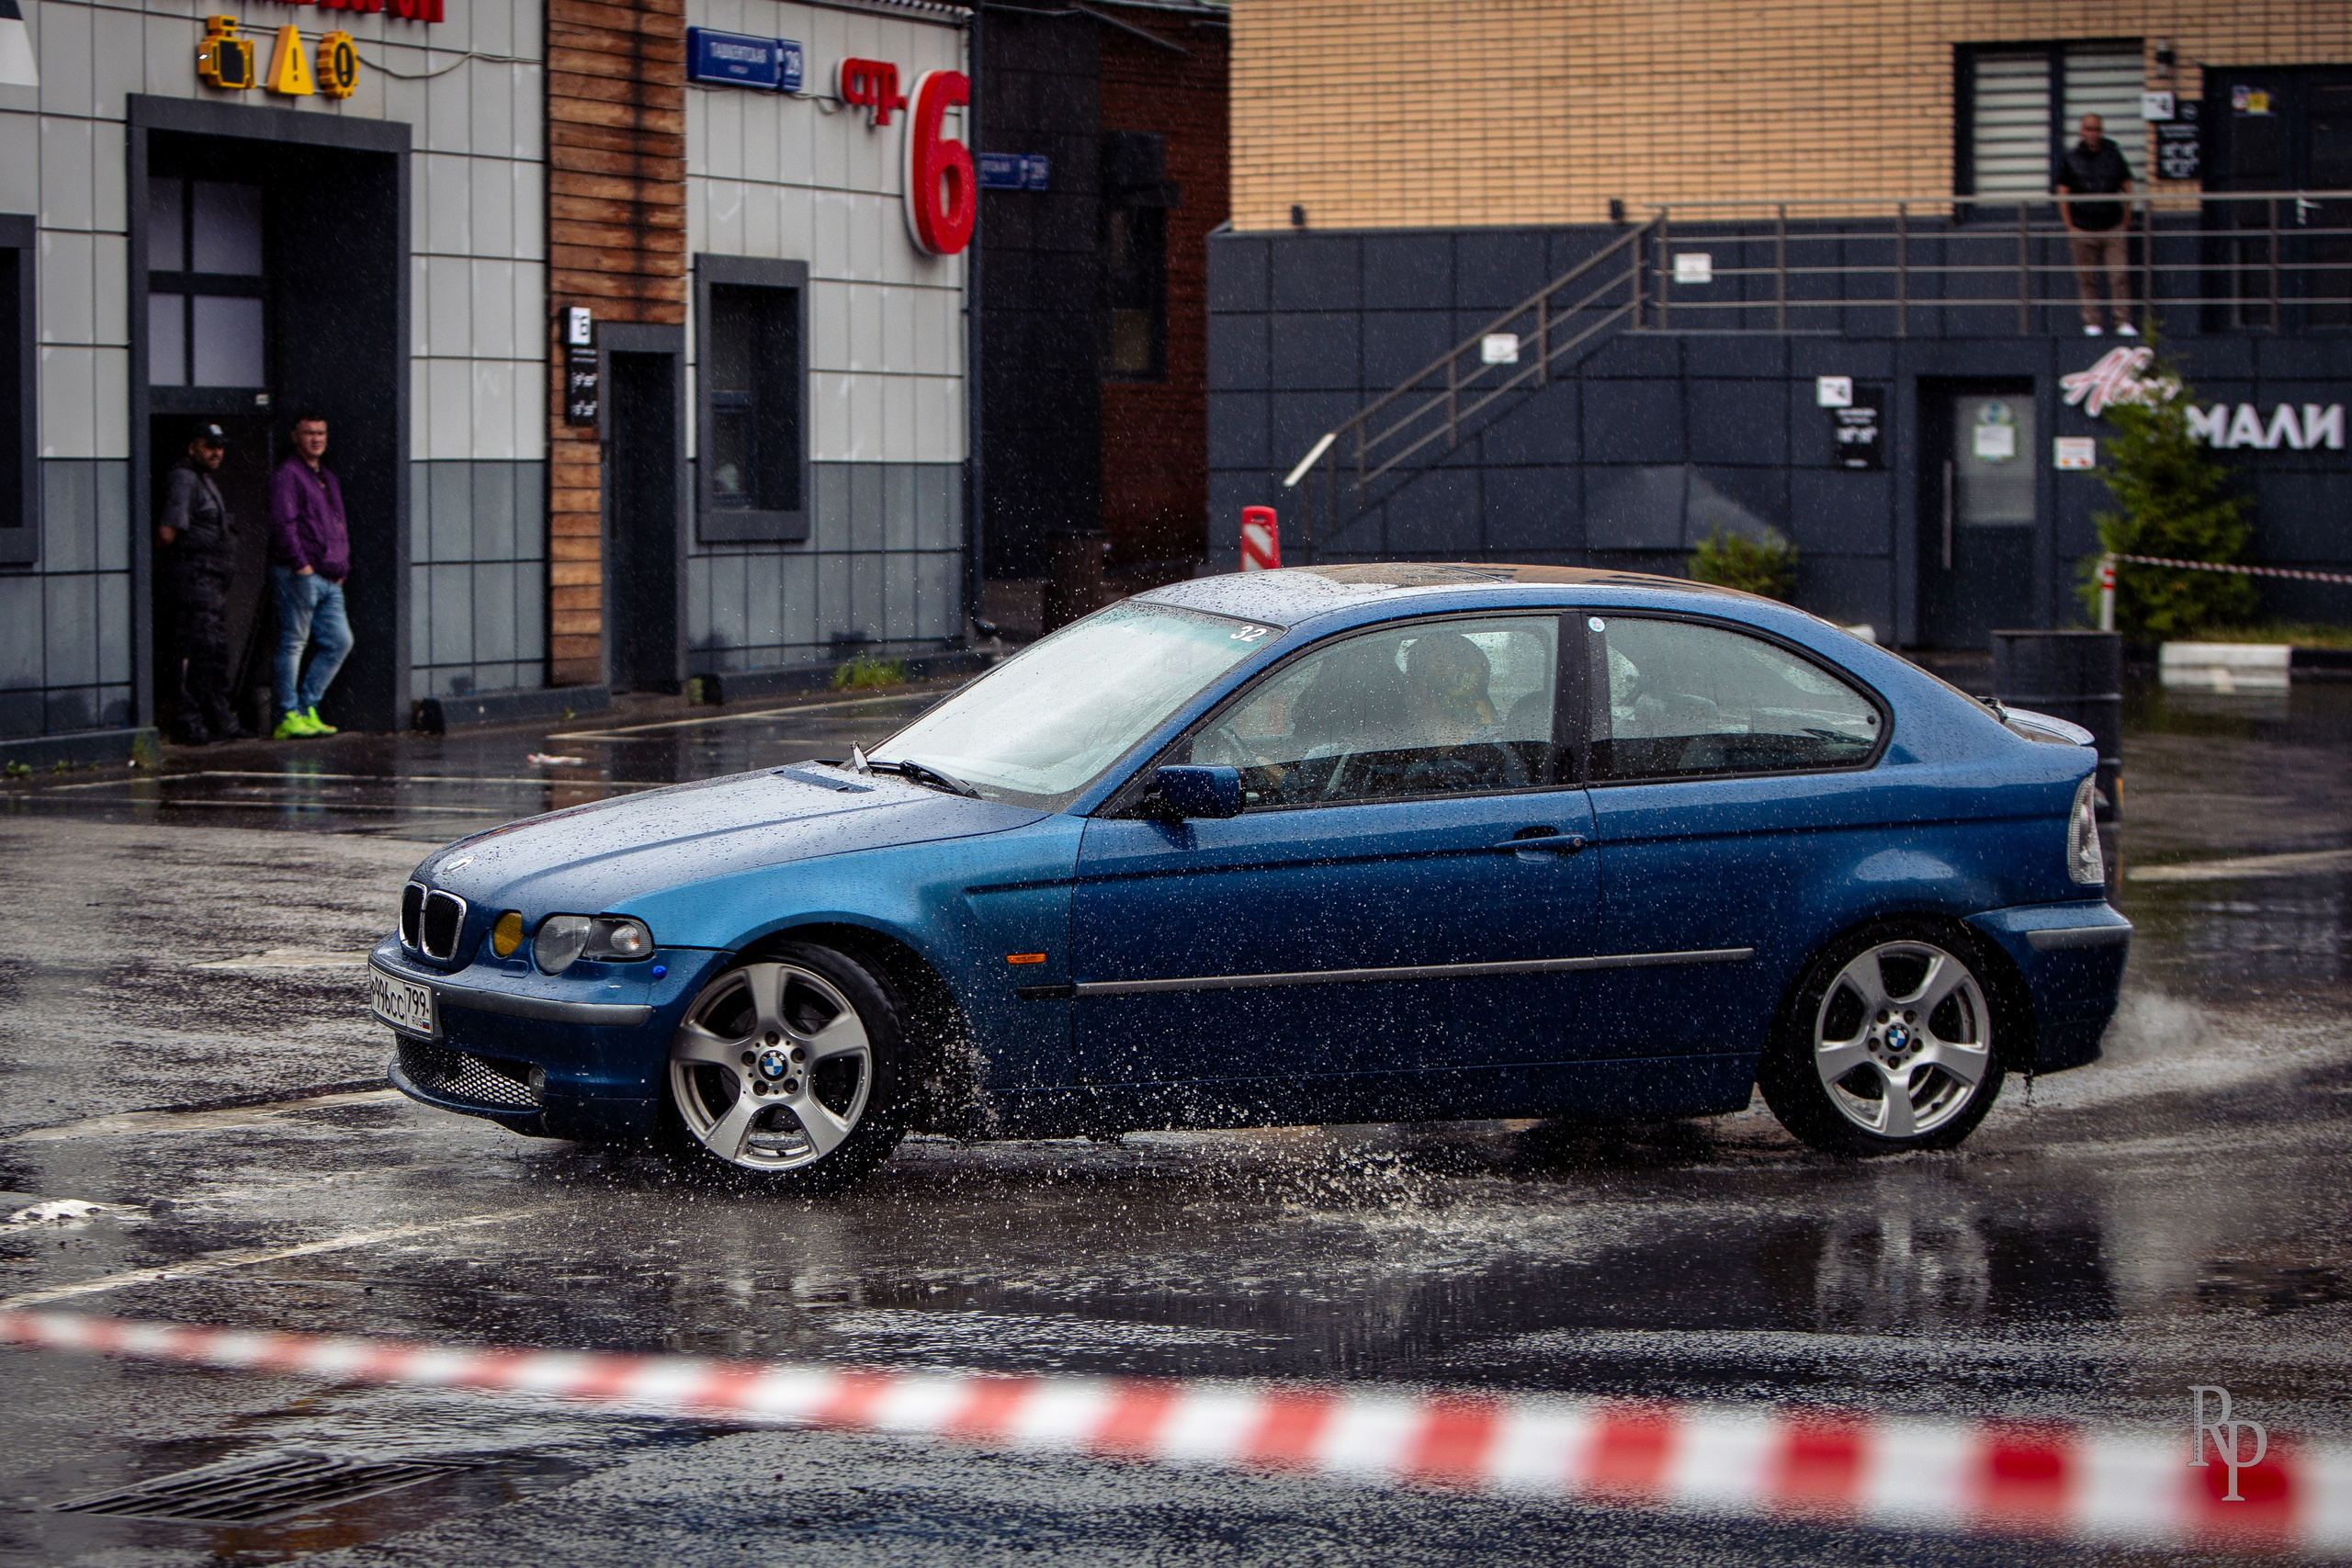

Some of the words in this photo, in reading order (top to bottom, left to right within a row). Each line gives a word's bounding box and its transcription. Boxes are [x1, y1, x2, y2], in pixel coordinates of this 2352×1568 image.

[905, 69, 978, 255] 6
[1230, 626, 1268, 643] 32
[405, 987, 426, 1017] 799
[412, 1015, 423, 1027] RUS
